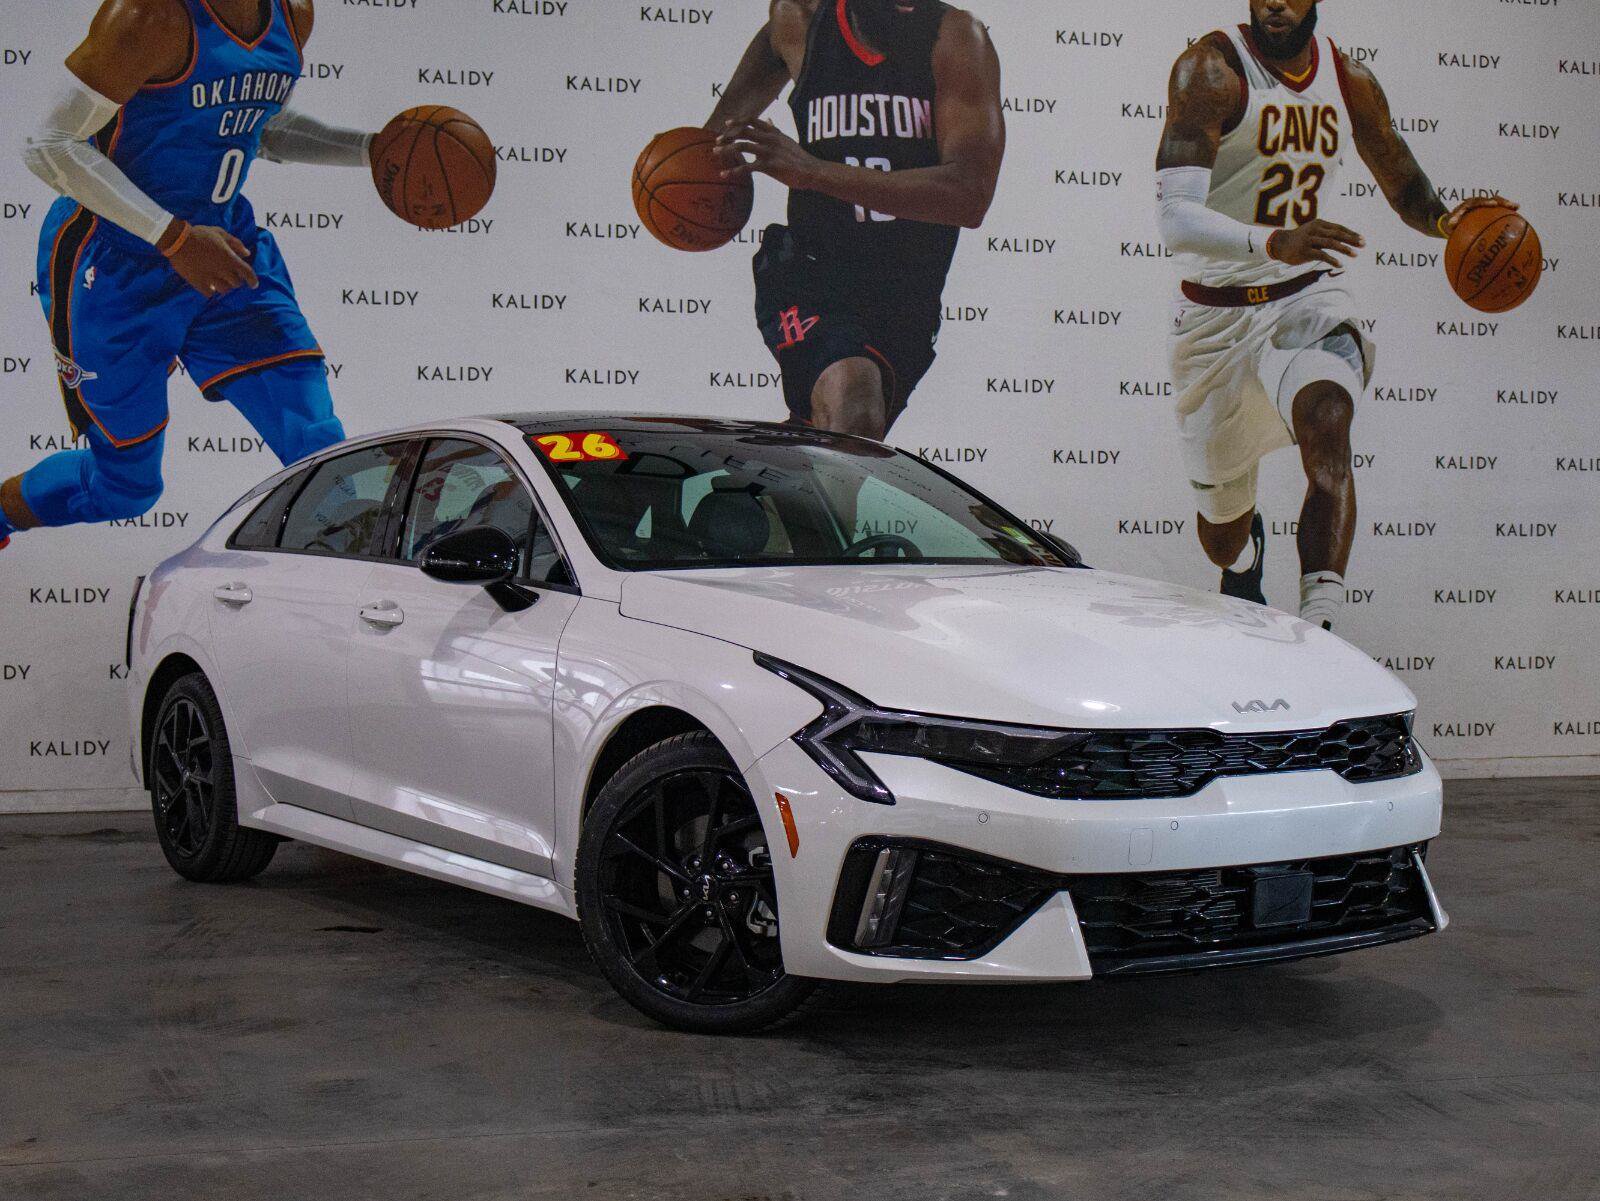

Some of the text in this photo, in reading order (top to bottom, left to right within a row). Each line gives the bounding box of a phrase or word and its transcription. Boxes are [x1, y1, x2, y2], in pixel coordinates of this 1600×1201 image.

[494, 0, 567, 16] KALIDY
[641, 7, 713, 24] KALIDY
[1056, 30, 1123, 47] KALIDY
[1439, 53, 1500, 68] KALIDY
[1559, 60, 1600, 75] KALI
[300, 64, 344, 79] IDY
[419, 69, 493, 86] KALIDY
[192, 73, 292, 109] OKLAHOM
[567, 76, 641, 93] KALIDY
[1001, 98, 1056, 113] ALIDY
[1122, 104, 1170, 118] KALI
[218, 108, 265, 137] CITY
[808, 94, 931, 143] HOUSTON
[1391, 117, 1439, 132] ALIDY
[1258, 104, 1338, 157] CAVS
[1499, 123, 1560, 139] KALIDY
[494, 147, 567, 162] KALIDY
[211, 149, 245, 202] 0
[1056, 170, 1122, 186] KALIDY
[1254, 162, 1325, 227] 23
[1559, 193, 1600, 208] KALI
[267, 213, 343, 229] KALIDY
[567, 223, 641, 239] KALIDY
[988, 238, 1055, 254] KALIDY
[1376, 252, 1438, 267] KALIDY
[343, 290, 418, 305] KALIDY
[493, 294, 566, 309] KALIDY
[1247, 287, 1269, 302] CLE
[640, 298, 711, 314] KALIDY
[941, 307, 988, 321] LIDY
[1055, 310, 1121, 325] KALIDY
[1437, 322, 1498, 336] KALIDY
[1558, 325, 1600, 340] KALI
[418, 366, 492, 382] KALIDY
[566, 369, 639, 384] KALIDY
[710, 373, 781, 388] KALIDY
[987, 379, 1054, 394] KALIDY
[1120, 382, 1171, 396] KALID
[1375, 388, 1437, 402] KALIDY
[1497, 390, 1557, 404] KALIDY
[188, 437, 264, 452] KALIDY
[537, 433, 619, 459] 26
[919, 448, 987, 462] KALIDY
[1054, 450, 1120, 465] KALIDY
[1436, 456, 1497, 470] KALIDY
[856, 520, 917, 534] ALIDY
[1119, 520, 1185, 535] KALIDY
[1374, 523, 1436, 537] KALIDY
[1496, 523, 1556, 537] KALIDY
[31, 588, 110, 604] KALIDY
[1346, 590, 1373, 603] IDY
[1435, 590, 1496, 604] KALIDY
[1495, 656, 1555, 670] KALIDY
[1231, 699, 1290, 713] KIA
[1434, 723, 1495, 737] KALIDY
[1554, 722, 1600, 735] KALID
[31, 741, 110, 757] KALIDY
